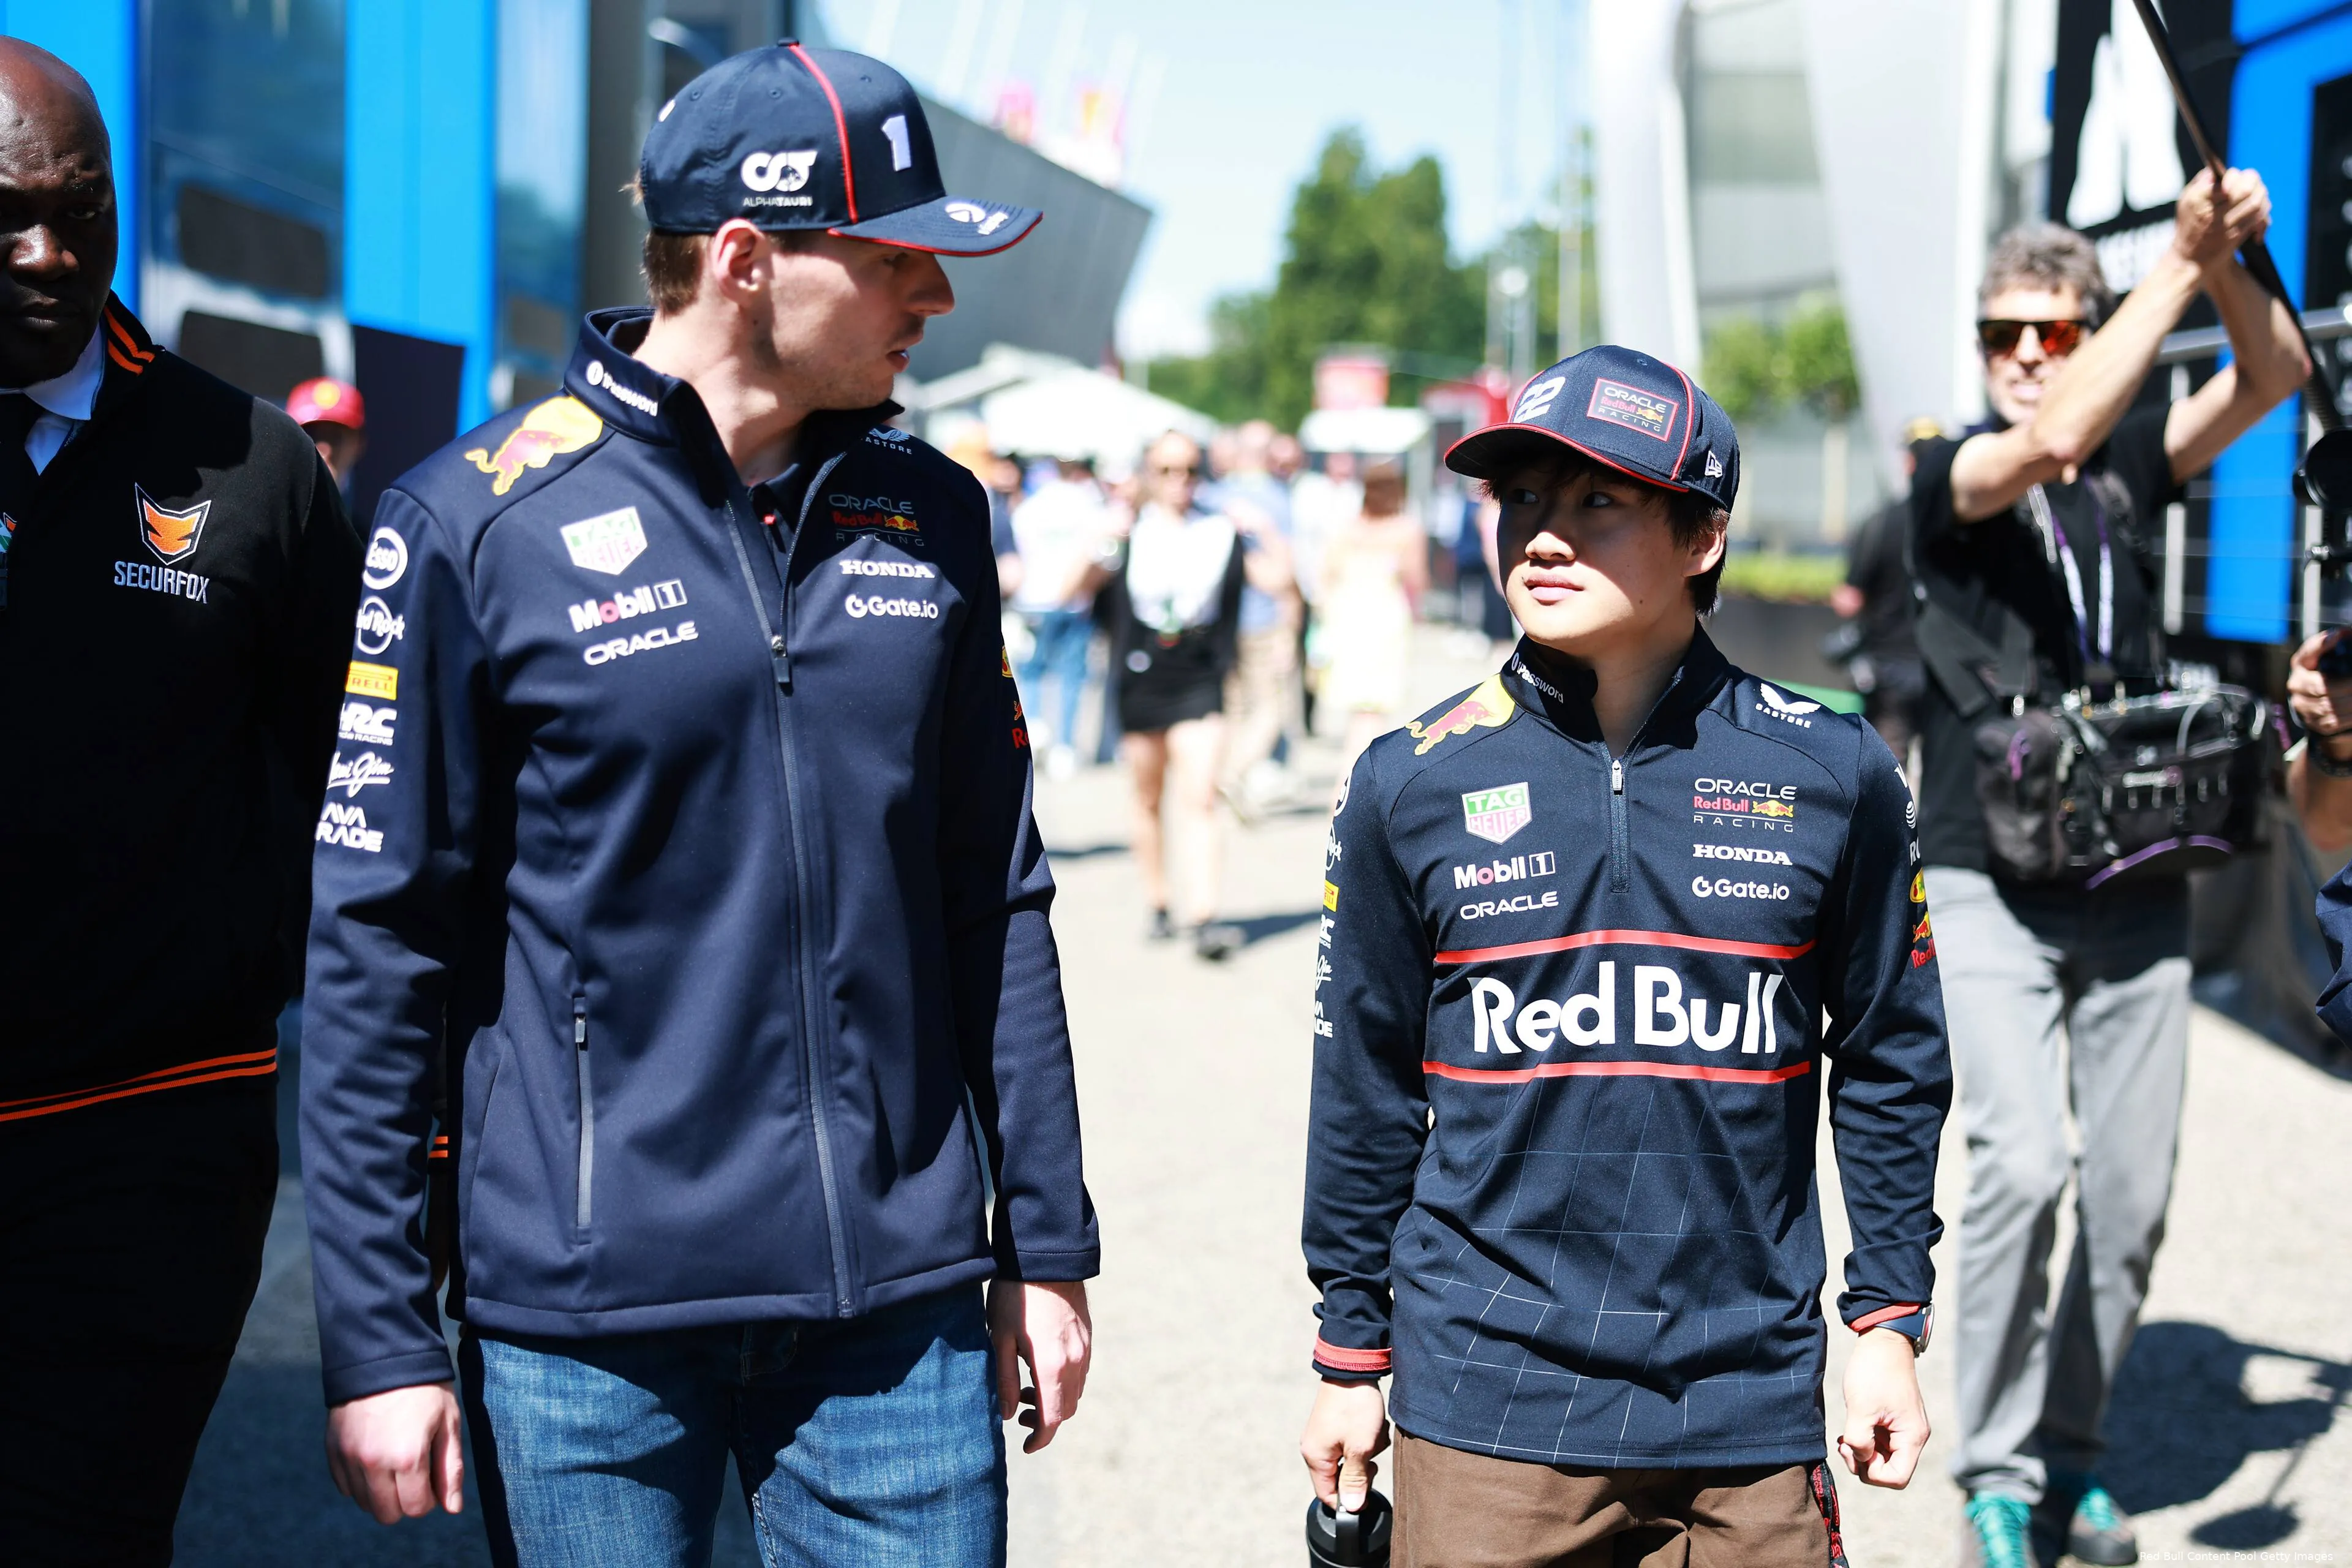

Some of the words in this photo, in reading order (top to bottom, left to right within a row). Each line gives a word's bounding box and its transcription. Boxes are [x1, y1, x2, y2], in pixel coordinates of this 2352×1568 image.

[881, 115, 911, 172] 1
[743, 195, 813, 207] ALPHATAURI
[1513, 376, 1566, 424] 22
[1600, 396, 1618, 407] Red
[1618, 400, 1637, 413] Bull
[1604, 386, 1667, 413] ORACLE
[1598, 407, 1662, 432] RACING
[861, 436, 913, 455] ASTORE
[829, 494, 914, 514] ORACLE
[831, 511, 857, 526] Red
[857, 511, 884, 526] Bull
[836, 532, 925, 547] RACING
[839, 560, 935, 578] HONDA
[114, 560, 210, 604] SECURFOX
[568, 584, 657, 633] Mobil
[868, 595, 939, 619] Gate.io
[583, 620, 699, 666] ORACLE
[352, 677, 393, 693] RELLI
[1517, 661, 1564, 704] 1Password
[1468, 788, 1523, 813] TAG
[1694, 778, 1798, 800] ORACLE
[1693, 795, 1721, 810] Red
[1722, 797, 1749, 813] Bull
[1470, 807, 1528, 838] HEUER
[1693, 815, 1793, 833] RACING
[315, 821, 383, 853] RADE
[1693, 844, 1793, 865] HONDA
[1453, 856, 1527, 889] Mobil
[1714, 878, 1790, 900] Gate.io
[1460, 891, 1559, 920] ORACLE
[1467, 960, 1615, 1055] Red
[1634, 965, 1784, 1054] Bull
